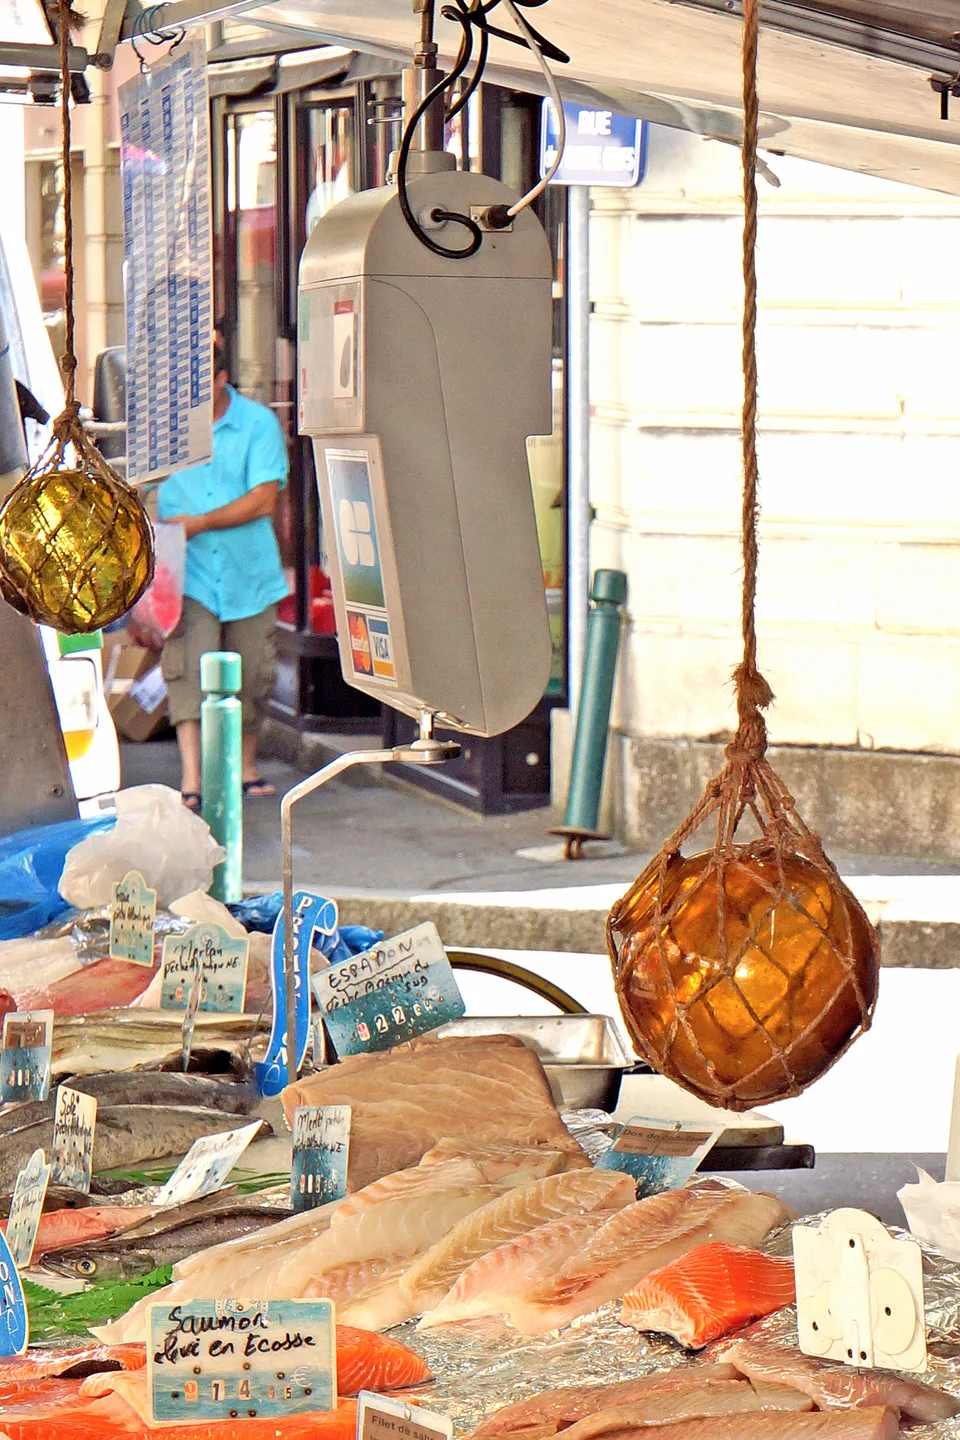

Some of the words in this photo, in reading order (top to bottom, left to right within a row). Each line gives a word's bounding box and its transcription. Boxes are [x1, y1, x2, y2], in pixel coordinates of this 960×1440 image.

[577, 110, 612, 135] RUE
[373, 634, 391, 660] VISA
[329, 937, 412, 988] ESPADON
[165, 1305, 268, 1336] Saumon
[208, 1340, 235, 1357] en
[244, 1332, 317, 1357] Ecosse
[371, 1415, 396, 1431] Filet
[398, 1425, 411, 1436] de
